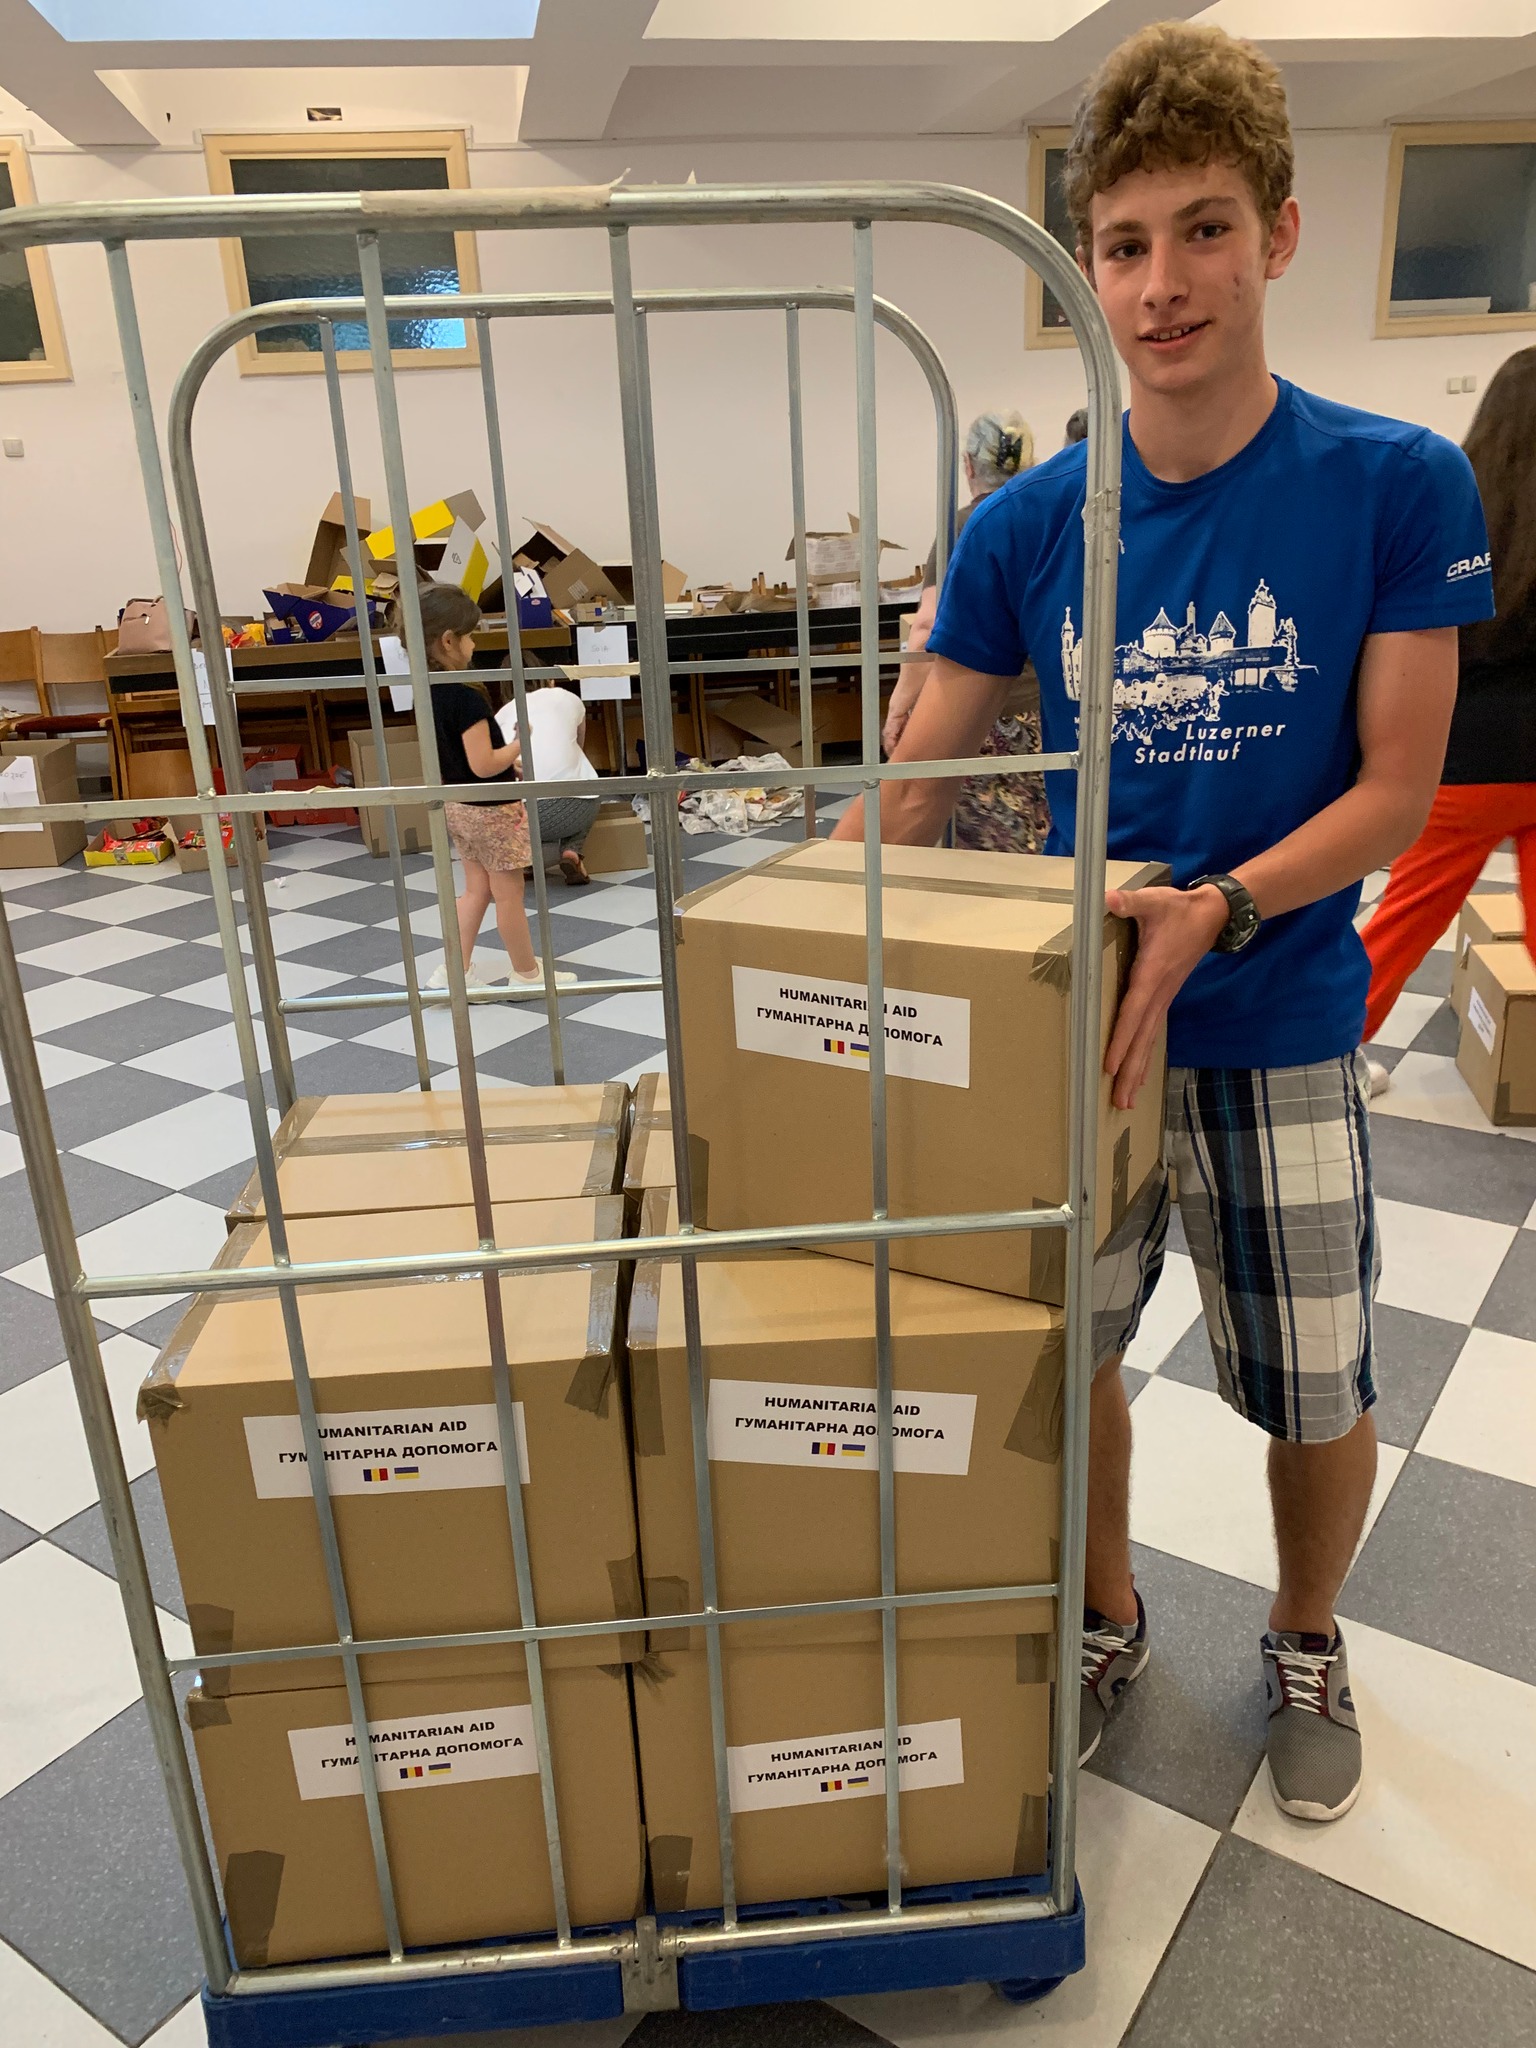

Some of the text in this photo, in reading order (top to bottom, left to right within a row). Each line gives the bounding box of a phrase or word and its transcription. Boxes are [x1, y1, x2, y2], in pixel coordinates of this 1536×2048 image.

[1185, 722, 1286, 739] Luzerner
[1135, 741, 1242, 764] Stadtlauf
[779, 987, 918, 1019] HUMANITARI AID
[756, 1007, 854, 1033] ГУМАНІТАРНА
[764, 1396, 921, 1416] HUMANITARIA AID
[318, 1420, 467, 1439] UMANITARIAN AID
[735, 1417, 945, 1440] ГУМАНІТАРНА ДООМОГА
[278, 1441, 498, 1464] ГУМНІТАРНА ДОПОМОГА
[345, 1721, 496, 1747] HMANITARIAN AID
[320, 1737, 524, 1769] ГУМАІТАРНА ДОПОМОГА
[770, 1736, 913, 1763] HUMANITARIAN ID
[747, 1751, 938, 1784] ГУМАНІТАРНА ДОПМОГА
